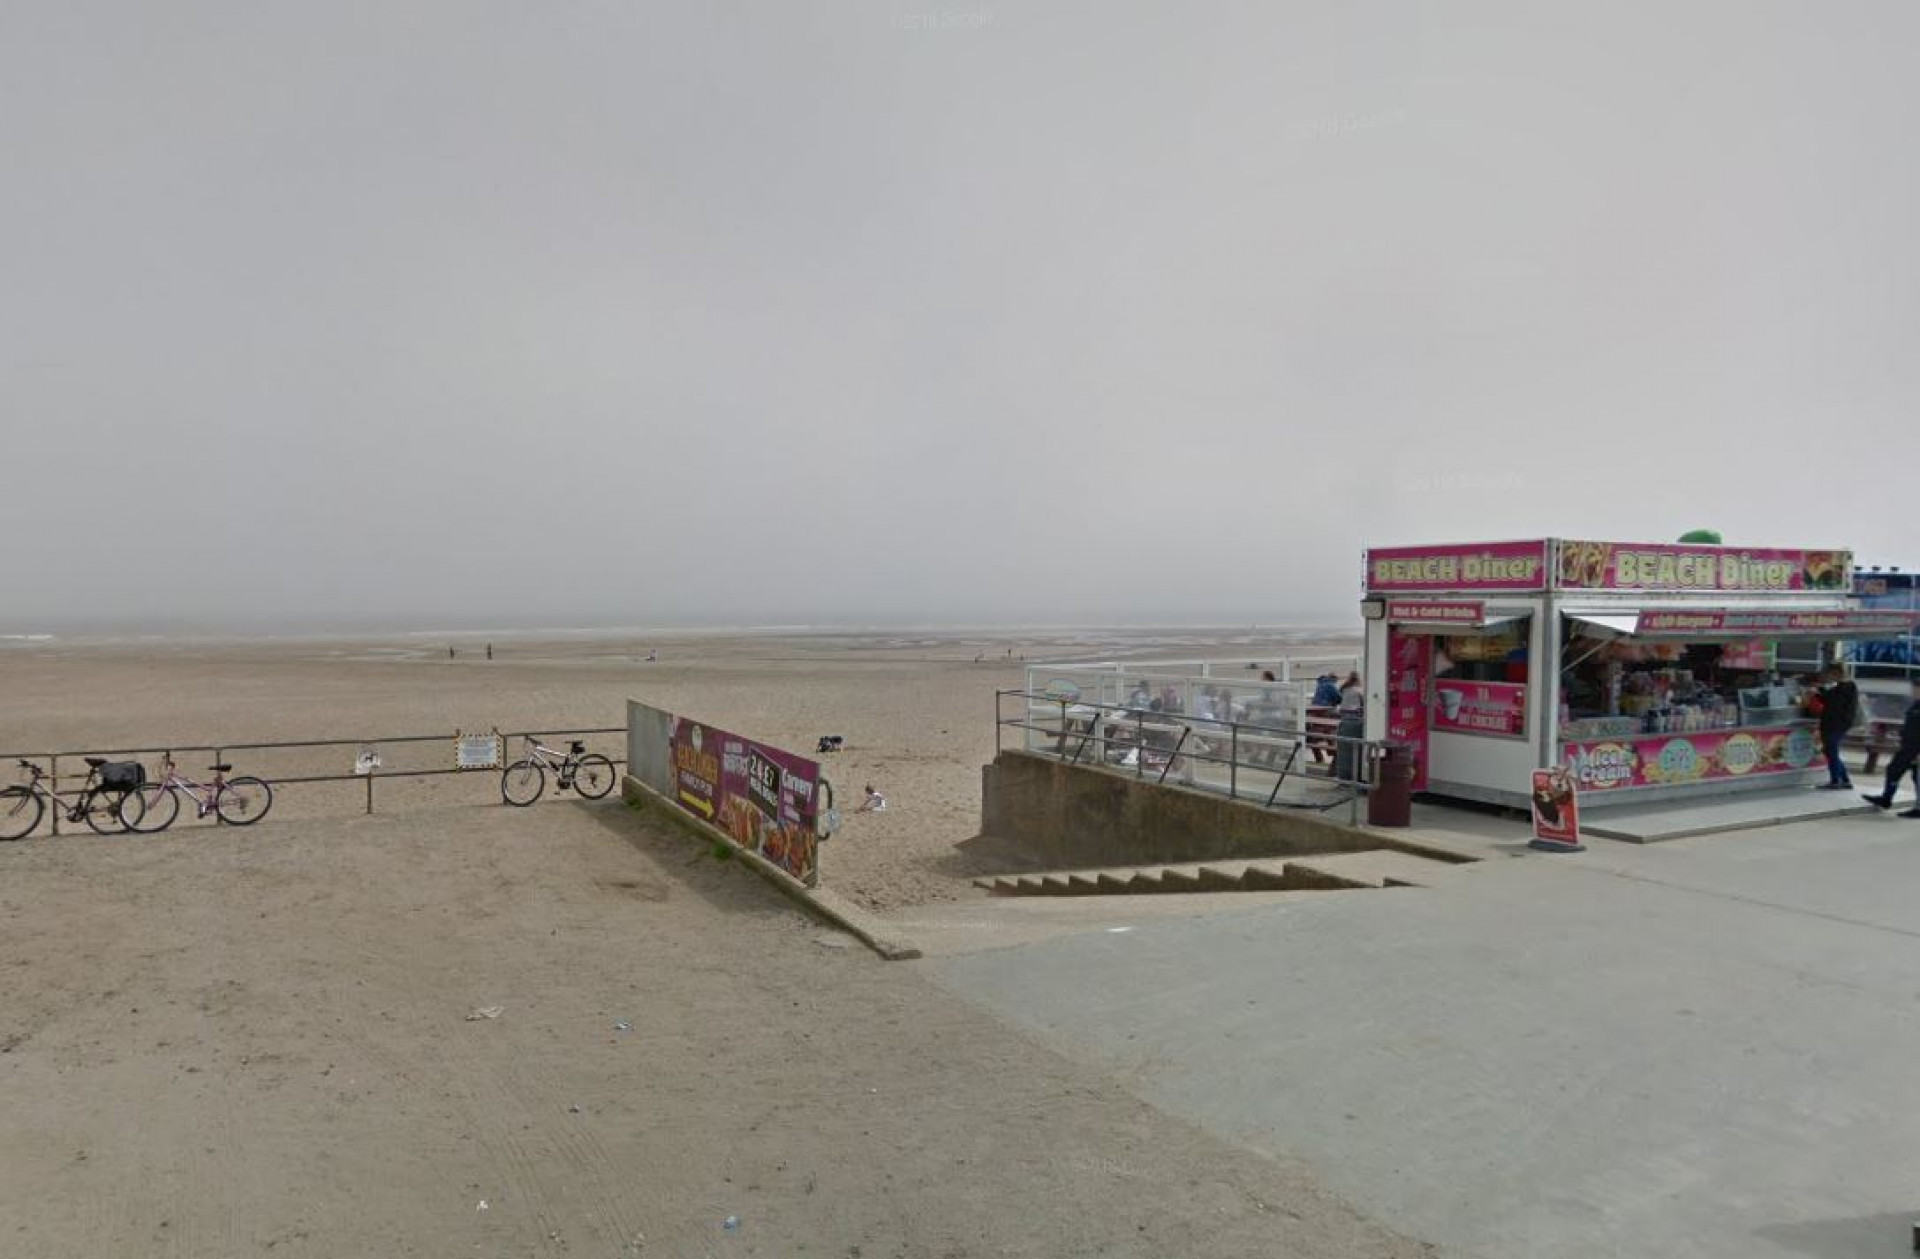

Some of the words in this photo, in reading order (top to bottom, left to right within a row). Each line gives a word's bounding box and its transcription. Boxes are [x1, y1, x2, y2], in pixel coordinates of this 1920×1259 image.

[1376, 557, 1457, 581] BEACH
[1464, 552, 1537, 580] Diner
[1617, 553, 1716, 586] BEACH
[1722, 553, 1792, 587] Diner
